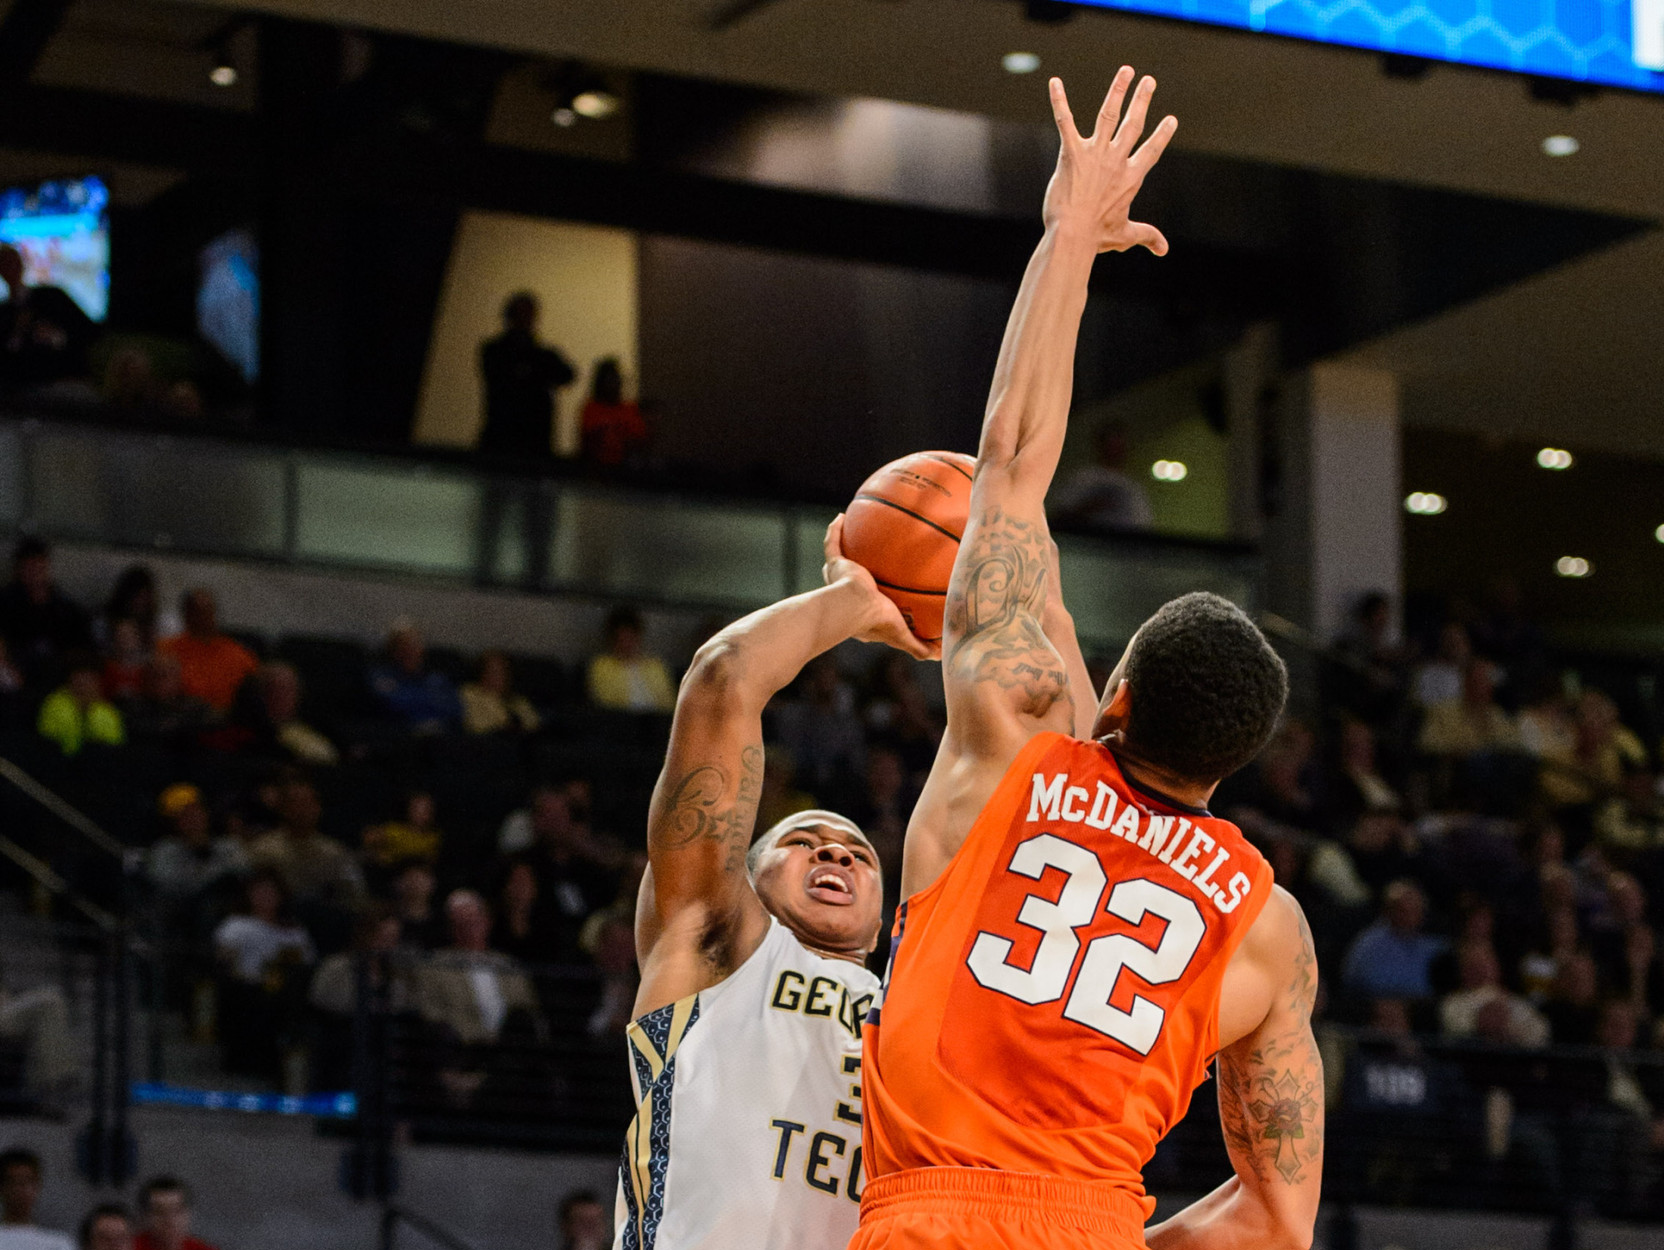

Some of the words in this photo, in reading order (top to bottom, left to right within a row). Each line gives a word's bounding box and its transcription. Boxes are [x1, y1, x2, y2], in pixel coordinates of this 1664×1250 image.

[966, 832, 1208, 1057] 32
[770, 969, 876, 1040] GEOR
[769, 1116, 864, 1205] TEC
